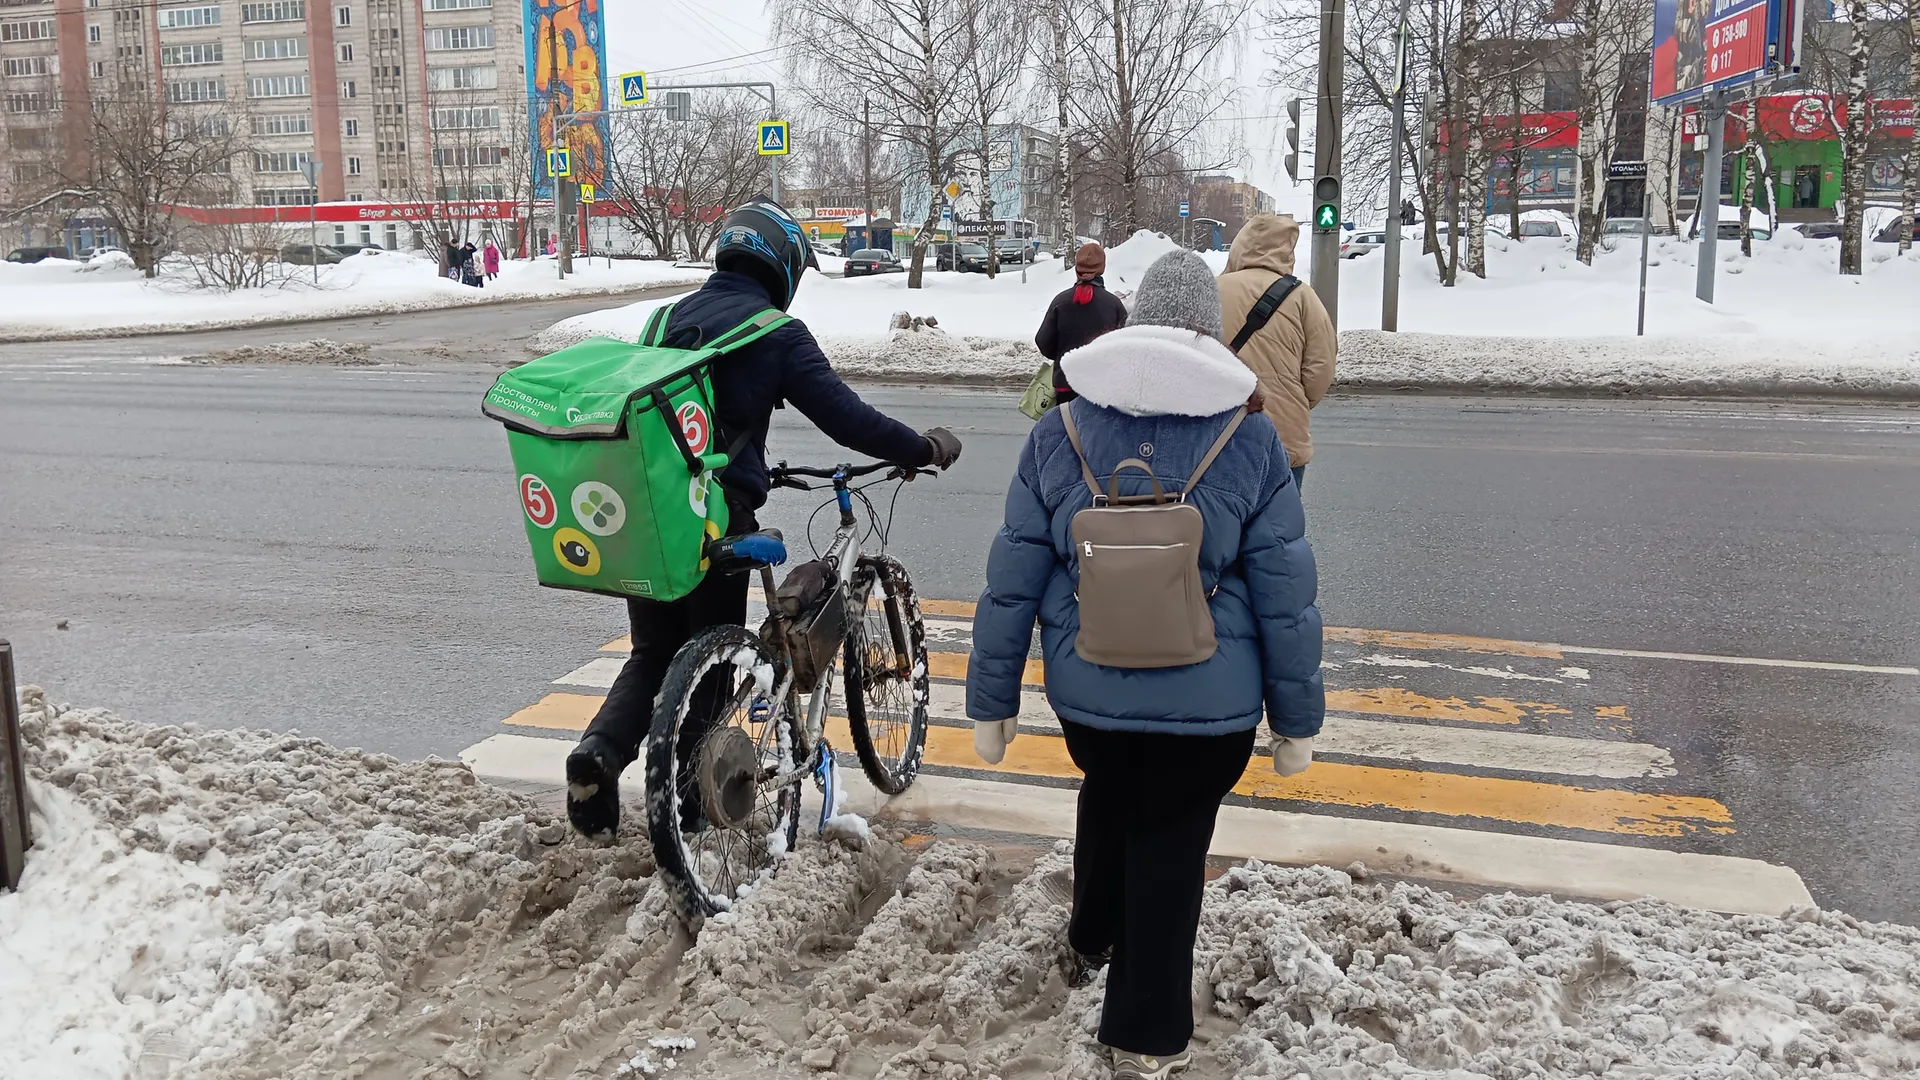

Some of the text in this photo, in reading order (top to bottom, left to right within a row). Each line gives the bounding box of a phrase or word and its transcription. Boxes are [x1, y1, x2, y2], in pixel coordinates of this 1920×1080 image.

[1720, 49, 1733, 70] 117
[965, 224, 1006, 232] ПЕКАНЯ
[490, 393, 540, 417] продукты
[495, 383, 558, 412] Доставляем
